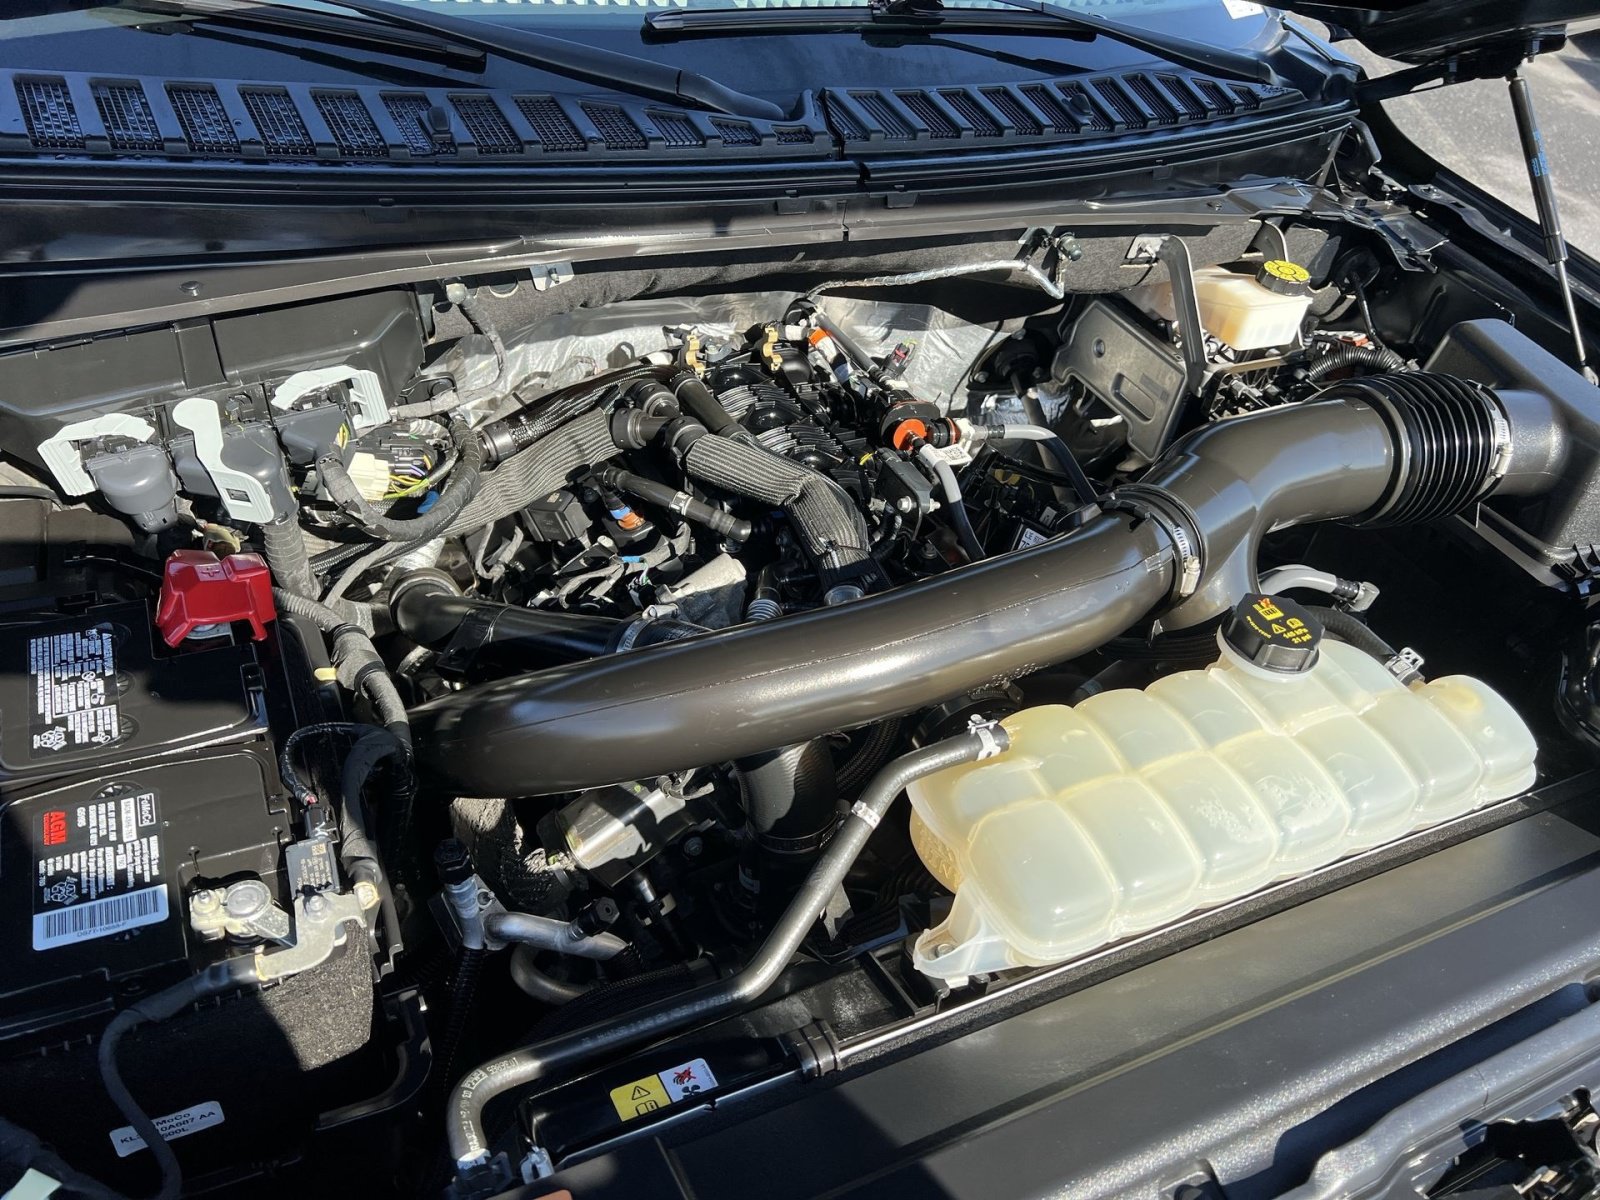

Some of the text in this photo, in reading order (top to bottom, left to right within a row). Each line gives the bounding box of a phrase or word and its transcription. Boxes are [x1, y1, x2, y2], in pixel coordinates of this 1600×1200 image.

[50, 811, 66, 845] AGM
[156, 1112, 190, 1126] MoCo
[160, 1117, 194, 1131] 0A687
[199, 1111, 216, 1120] AA
